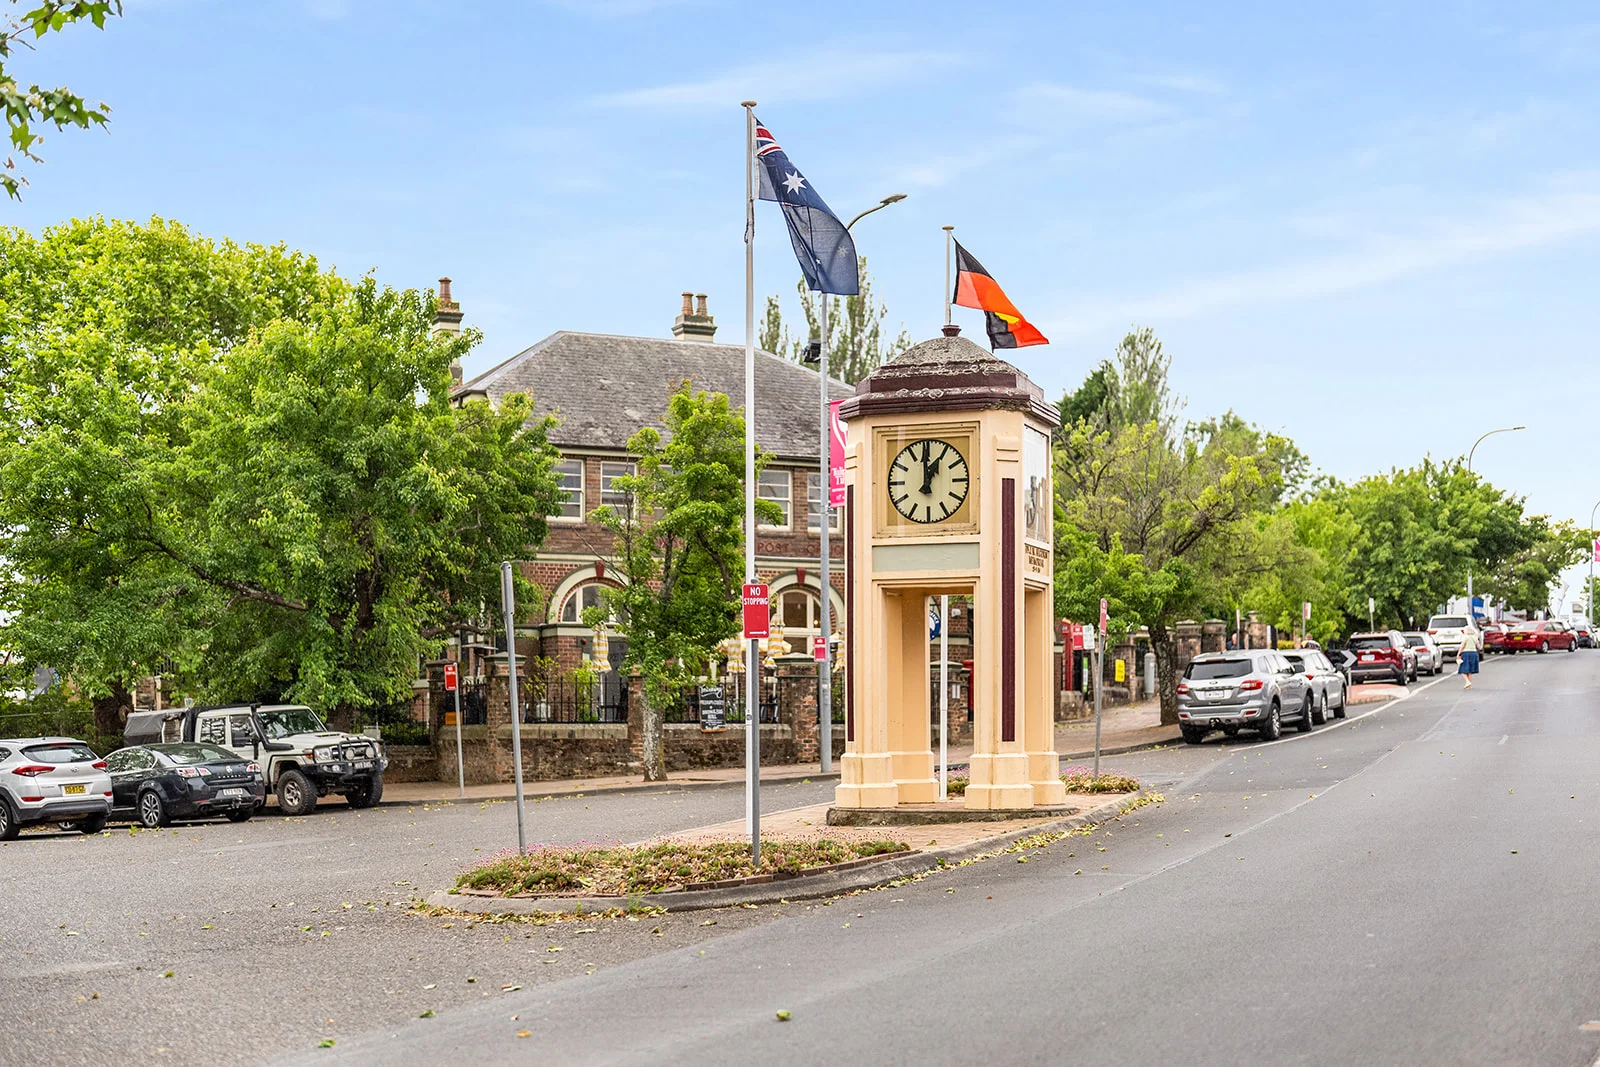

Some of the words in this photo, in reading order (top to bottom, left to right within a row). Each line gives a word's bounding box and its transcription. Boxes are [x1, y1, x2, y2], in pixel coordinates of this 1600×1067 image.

[757, 542, 789, 553] POST
[750, 586, 761, 596] NO
[743, 597, 768, 606] STOPPING
